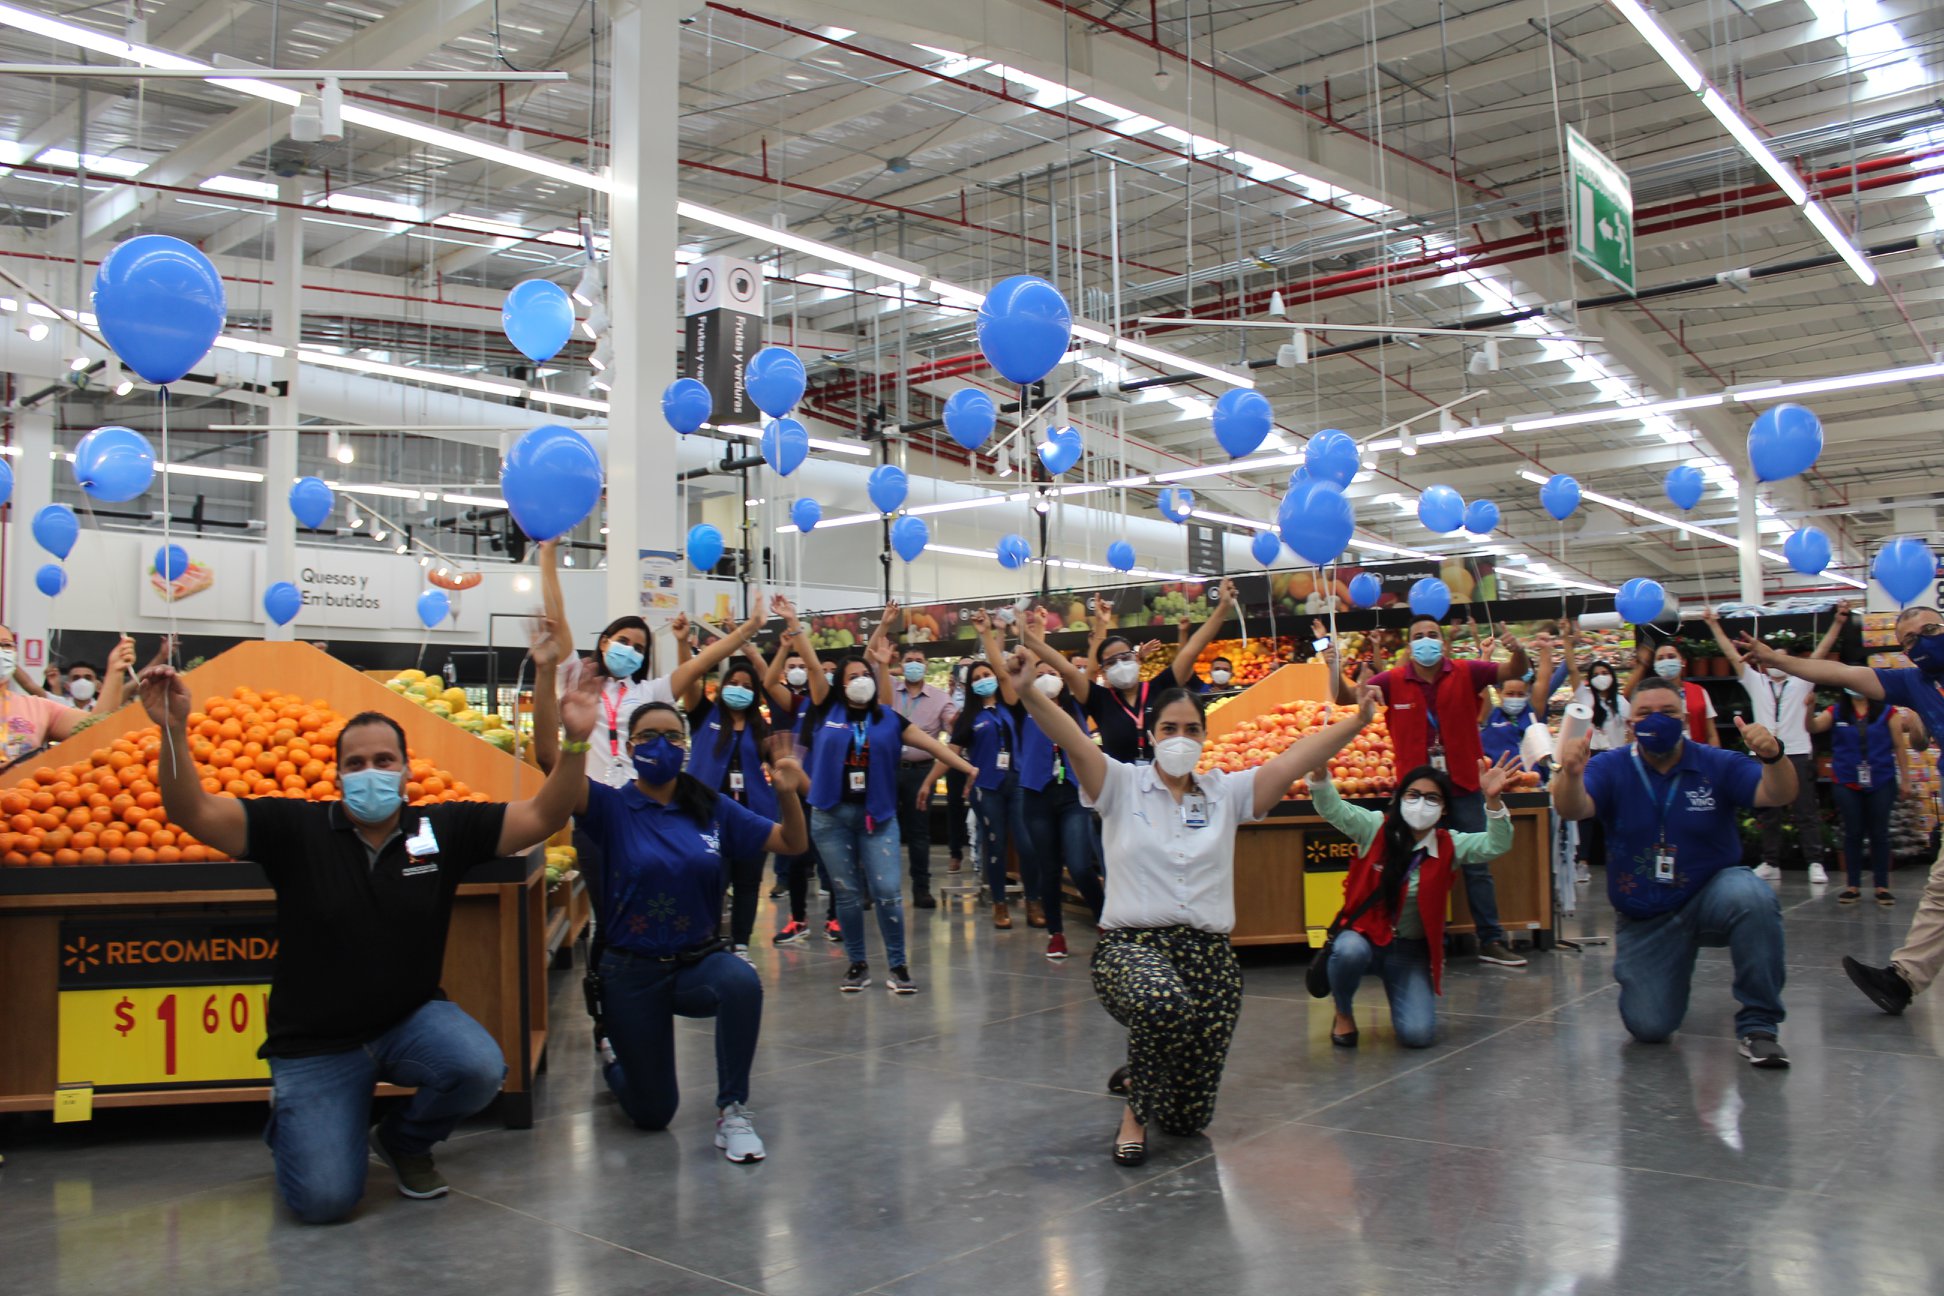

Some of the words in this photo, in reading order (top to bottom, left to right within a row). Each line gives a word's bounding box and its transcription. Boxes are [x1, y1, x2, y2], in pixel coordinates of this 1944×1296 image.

[697, 315, 708, 353] Frutas
[734, 315, 747, 352] Frutas
[695, 354, 705, 362] y
[732, 353, 744, 362] y
[733, 363, 745, 414] verduras
[301, 567, 356, 586] Quesos
[360, 576, 368, 591] y
[301, 590, 380, 609] Embutidos
[114, 996, 136, 1037] $
